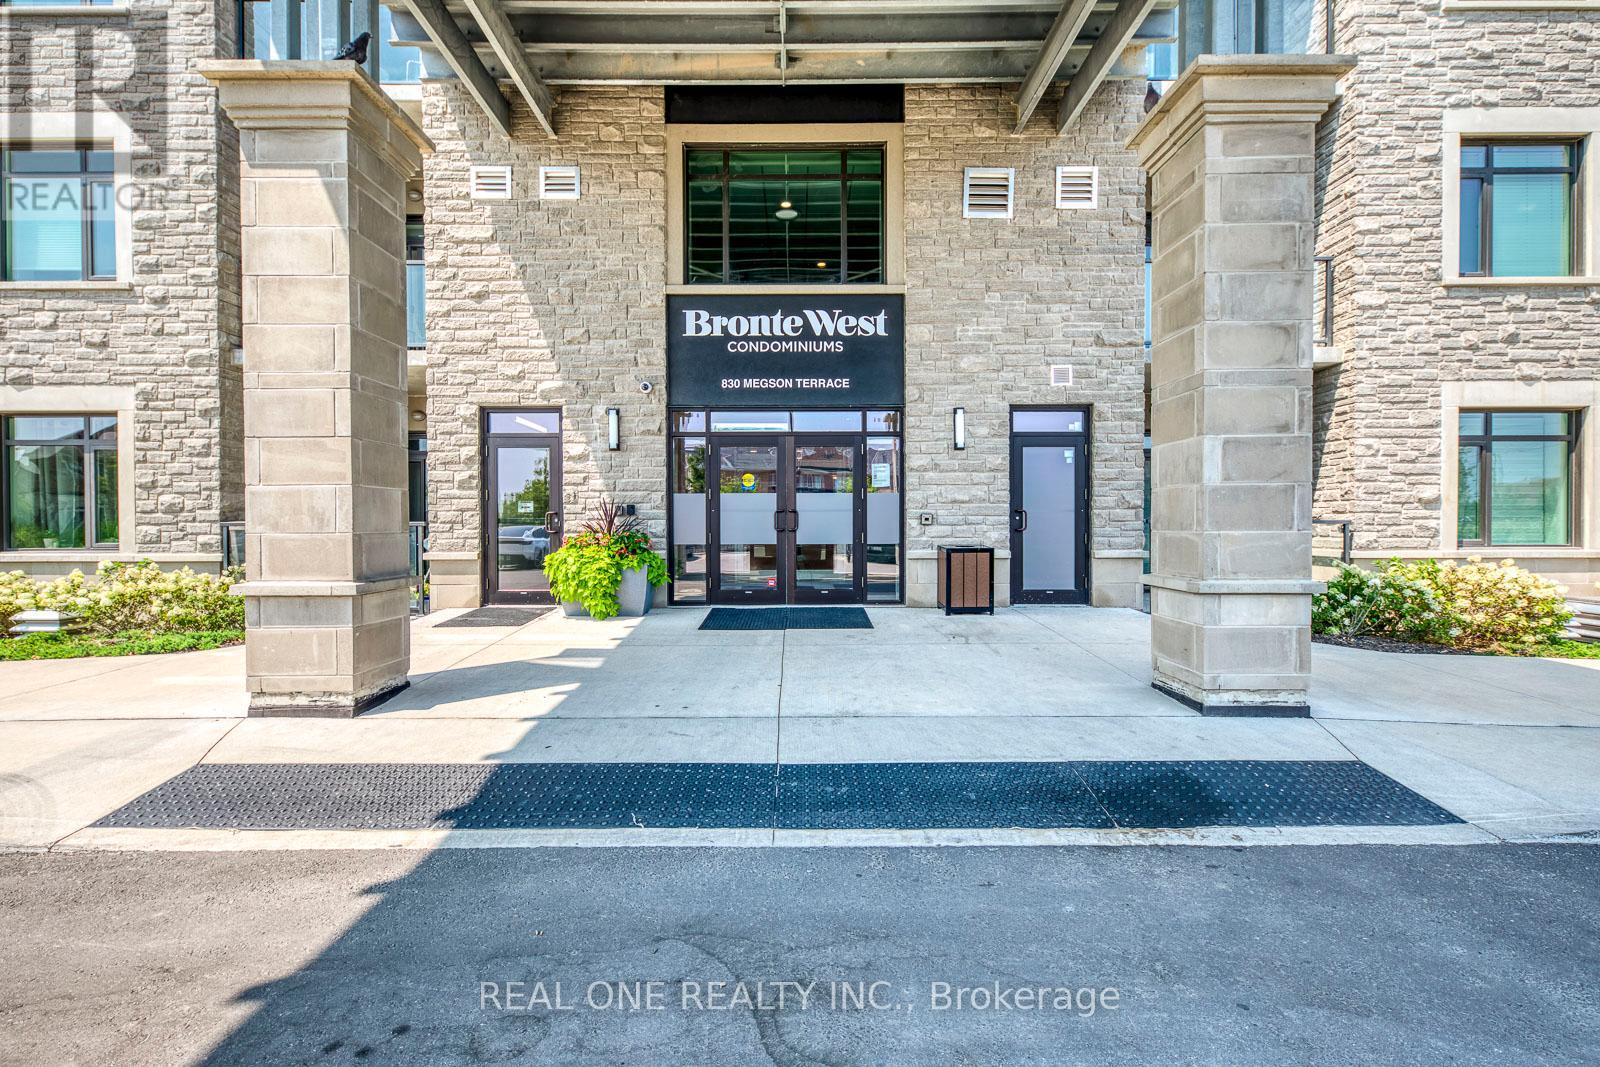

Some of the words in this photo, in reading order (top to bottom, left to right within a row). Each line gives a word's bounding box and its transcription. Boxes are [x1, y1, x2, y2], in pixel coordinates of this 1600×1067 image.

[727, 341, 844, 353] CONDOMINIUMS
[721, 378, 741, 389] 830
[743, 378, 793, 389] MEGSON
[795, 378, 850, 389] TERRACE
